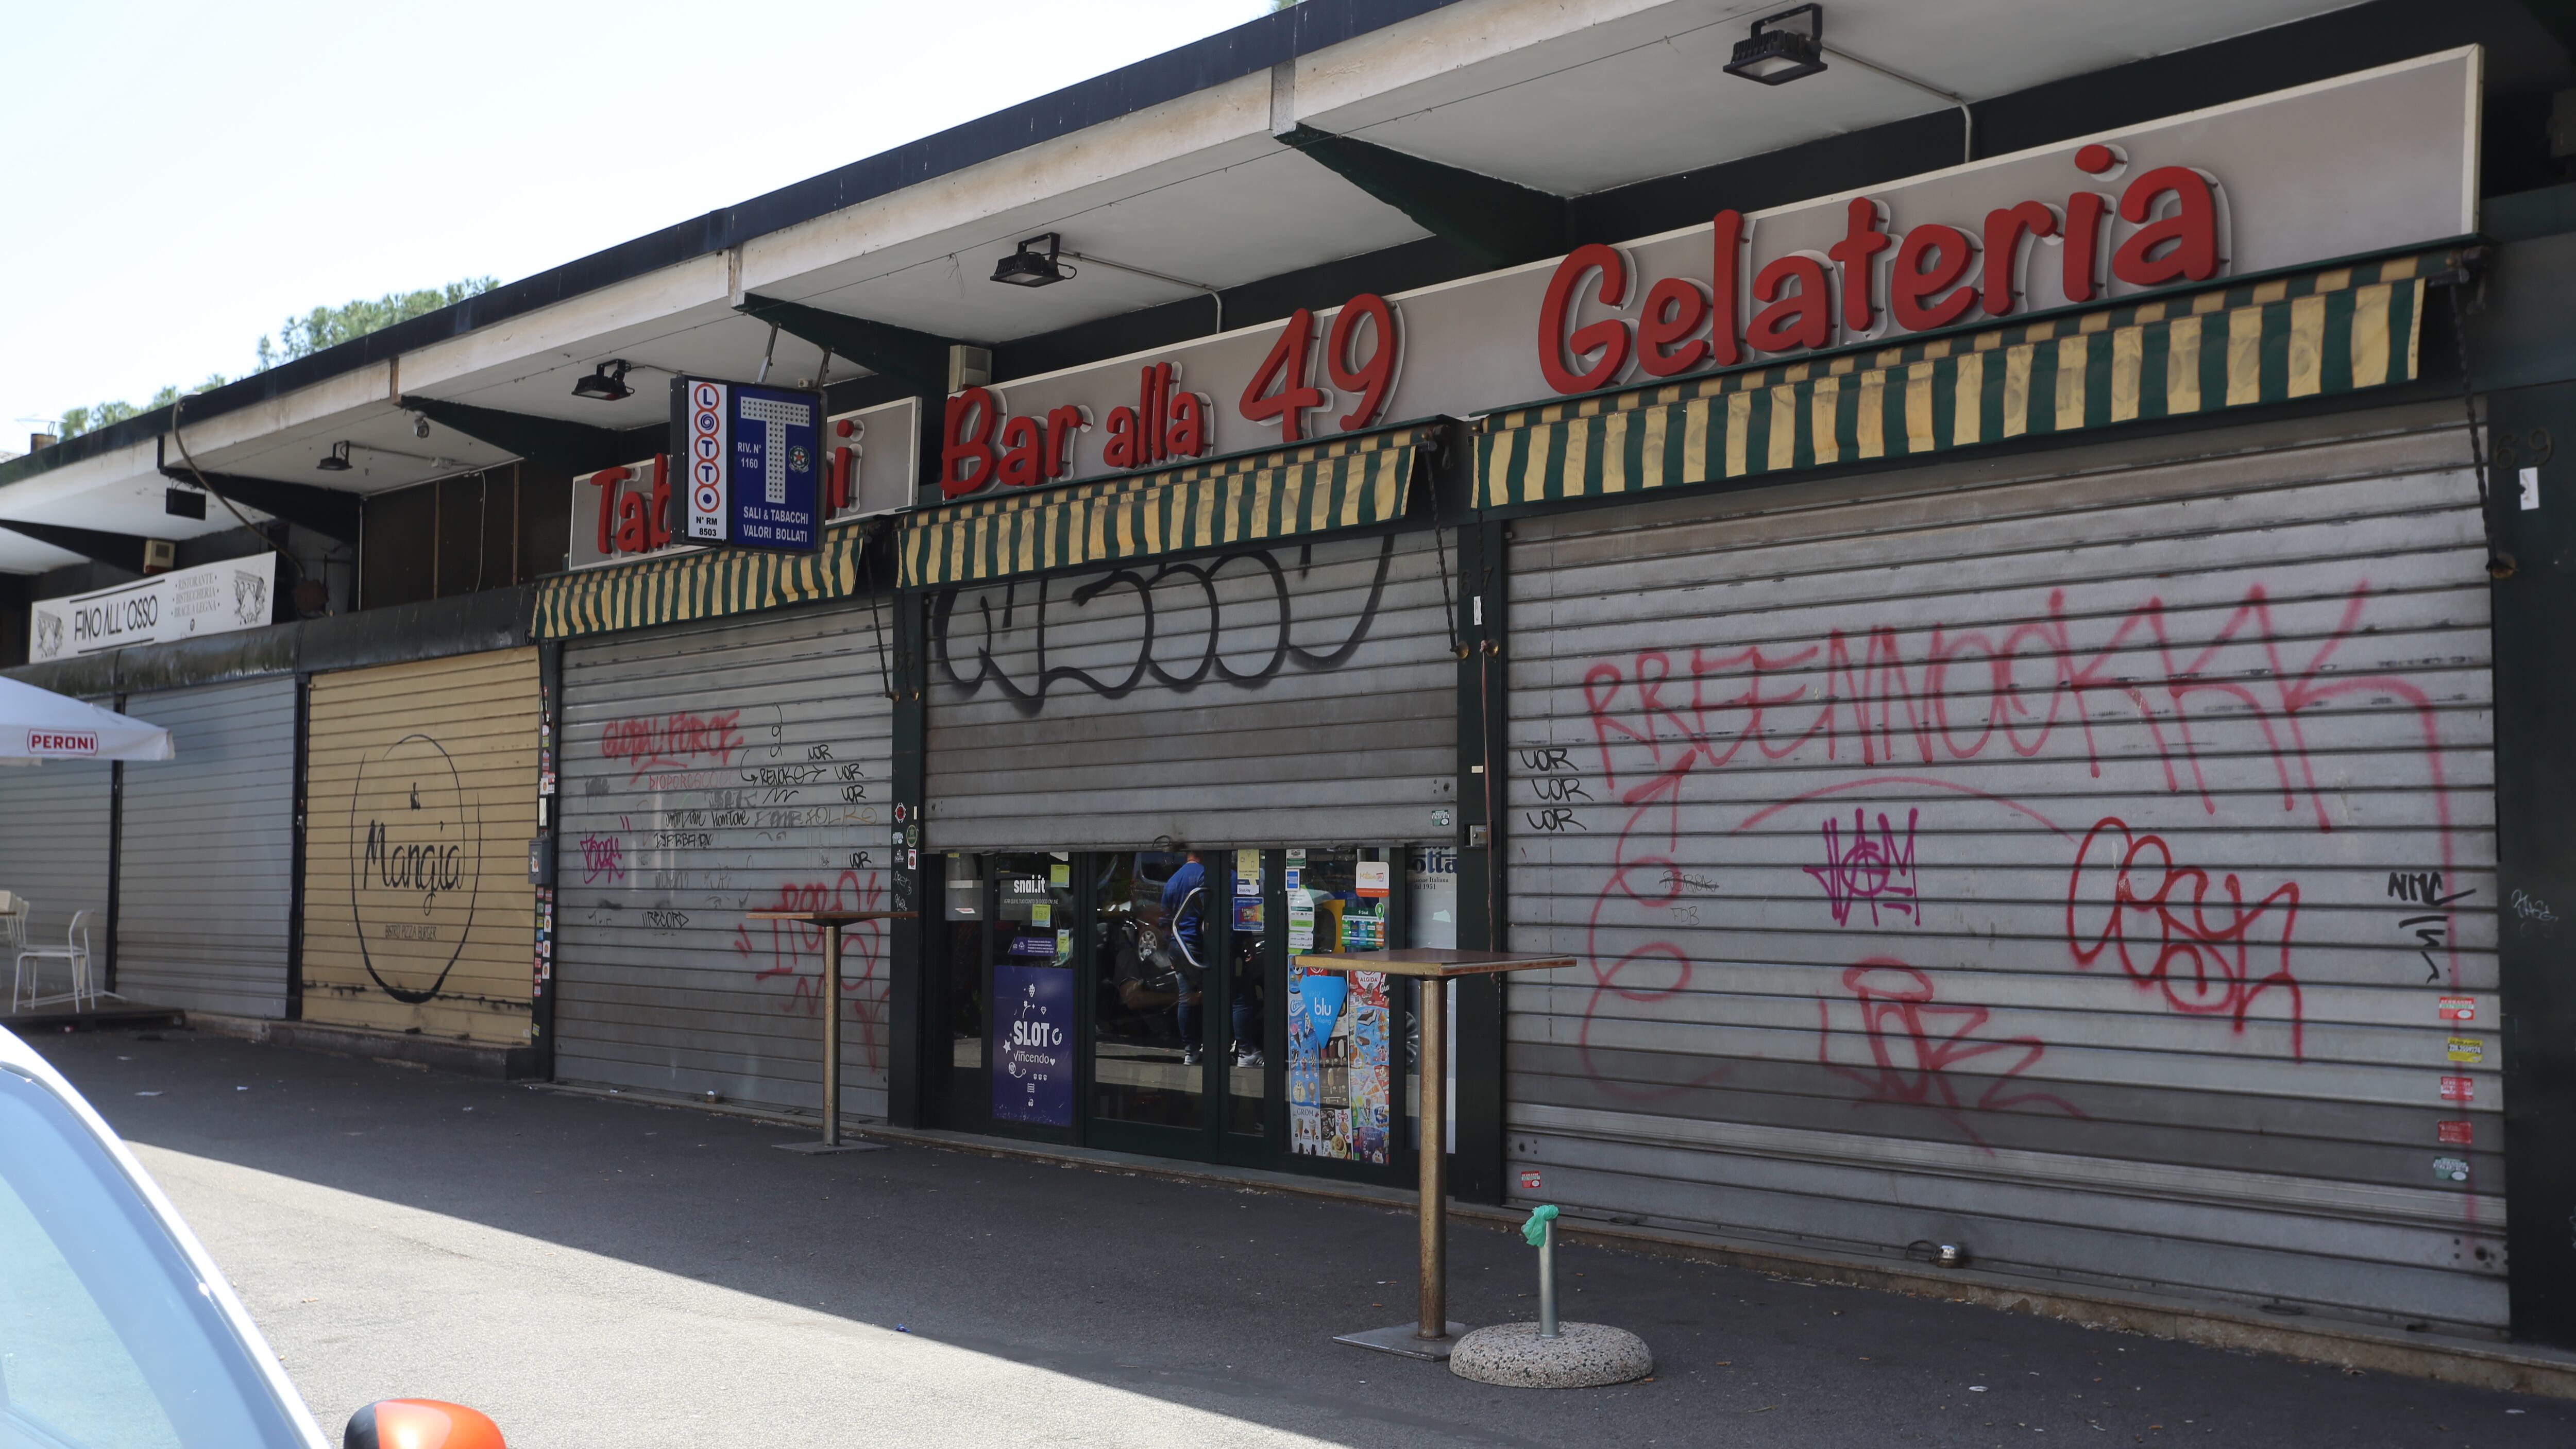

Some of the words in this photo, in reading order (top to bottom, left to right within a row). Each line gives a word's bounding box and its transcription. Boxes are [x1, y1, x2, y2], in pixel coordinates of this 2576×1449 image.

[940, 386, 1083, 499] Bar
[1103, 362, 1204, 469] alla
[1239, 293, 1397, 442] 49
[1537, 144, 2218, 395] Gelateria
[737, 442, 751, 453] RIV.
[2492, 428, 2553, 470] 69
[741, 458, 758, 469] 1160
[706, 517, 717, 526] RM
[743, 506, 761, 518] SALI
[764, 509, 768, 519] &
[771, 509, 808, 524] TABACCHI
[699, 527, 717, 536] 8503
[743, 525, 771, 538] VALORI
[776, 527, 807, 542] BOLLATI
[179, 573, 213, 589] RISTORANTE
[74, 605, 102, 642] FINO
[31, 733, 94, 751] PERONI
[363, 819, 466, 916] Mangia
[1014, 875, 1045, 893] snai.it
[401, 925, 417, 940] PIZZA
[418, 926, 437, 940] BURGER
[1314, 998, 1331, 1016] blu
[1013, 1020, 1050, 1047] SLOT
[1297, 1108, 1314, 1116] GROM
